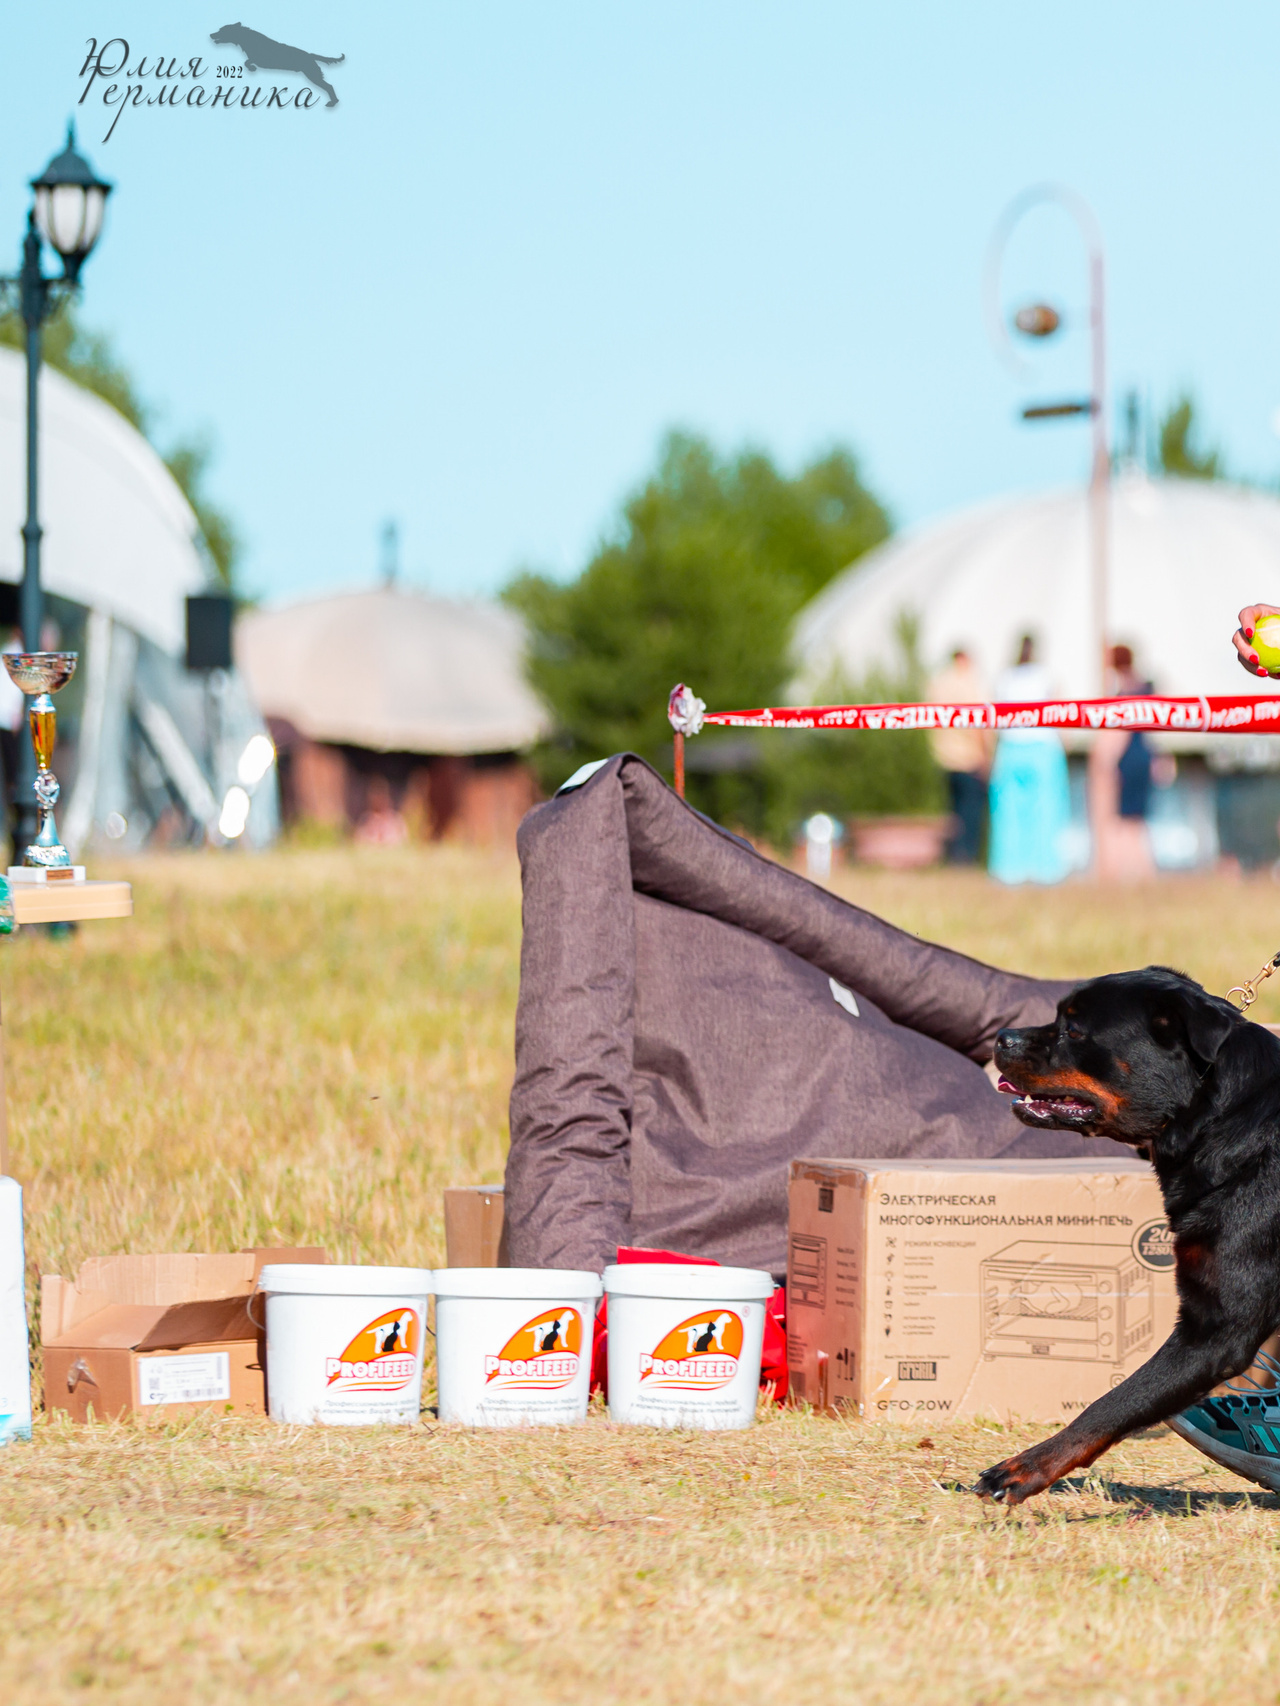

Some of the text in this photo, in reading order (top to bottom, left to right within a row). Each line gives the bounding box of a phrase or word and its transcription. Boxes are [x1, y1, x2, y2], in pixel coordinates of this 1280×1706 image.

[864, 706, 985, 729] ТРАПЕЗА
[1042, 703, 1078, 723] ВАШ
[1084, 701, 1202, 729] ТРАПЕЗА
[880, 1193, 996, 1206] ЭЛЕКТРИЧЕСКАЯ
[879, 1215, 1133, 1226] МНОГОФУНКЦИОНАЛЬНАЯ МИНИ-ПЕЧЬ
[326, 1357, 417, 1379] PROFIFEED
[485, 1355, 579, 1377] PROFIFEED
[640, 1353, 738, 1378] PROFIFEED
[877, 1400, 952, 1411] GFO-20W
